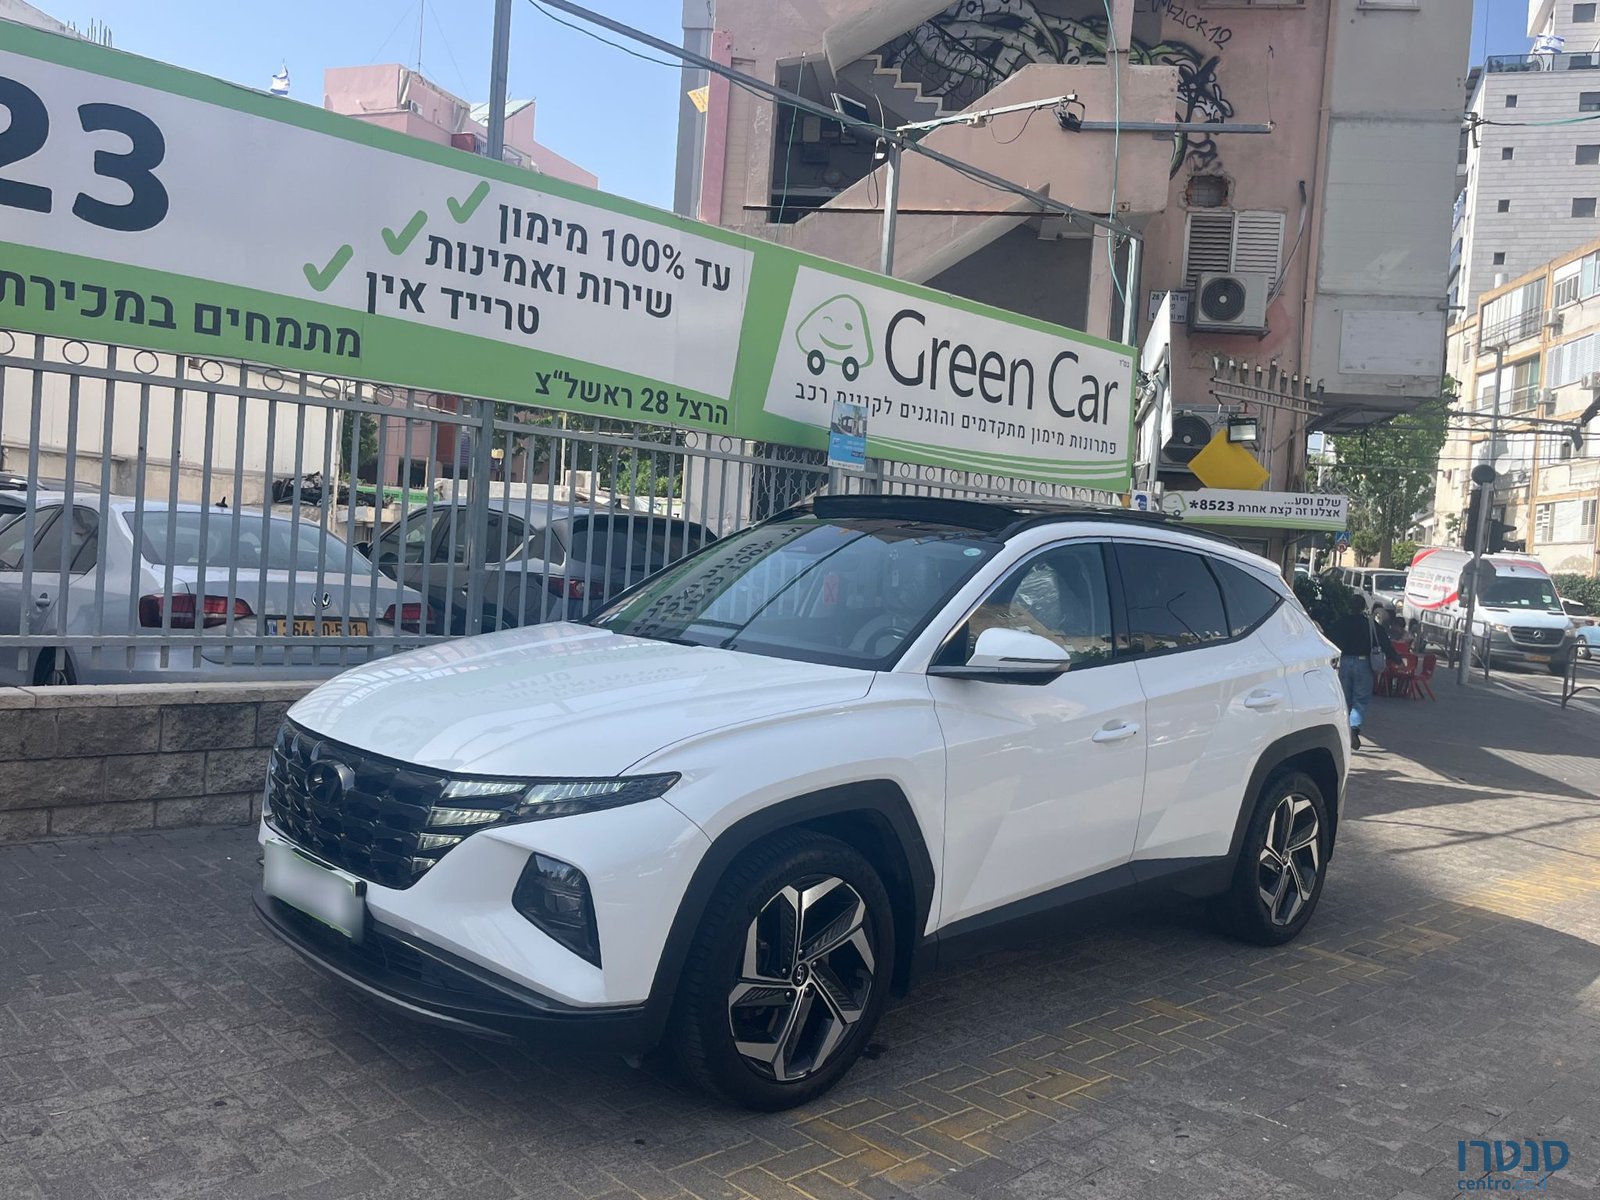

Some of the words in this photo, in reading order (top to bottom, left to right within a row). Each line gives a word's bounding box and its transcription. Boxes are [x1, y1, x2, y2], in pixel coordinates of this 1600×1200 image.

[499, 204, 587, 256] מימון
[425, 234, 566, 296] ואמינות
[602, 228, 686, 281] 100%
[694, 257, 731, 292] עד
[0, 270, 177, 330] במכירת
[366, 271, 428, 314] אין
[577, 270, 673, 319] שירות
[440, 287, 540, 335] טרייד
[194, 302, 361, 358] מתמחים
[885, 308, 1035, 411] Green
[1048, 350, 1119, 426] Car
[640, 387, 669, 415] 28
[795, 382, 829, 404] רכב
[676, 392, 729, 426] הרצל
[900, 402, 955, 427] והוגנים
[961, 416, 1026, 442] מתקדמים
[1031, 426, 1065, 447] מימון
[1068, 434, 1117, 456] פתרונות
[1238, 505, 1267, 513] אחרת
[1270, 506, 1292, 517] קצת
[1295, 508, 1307, 516] זה
[1311, 507, 1340, 517] אצלנו
[1317, 497, 1341, 507] שלם
